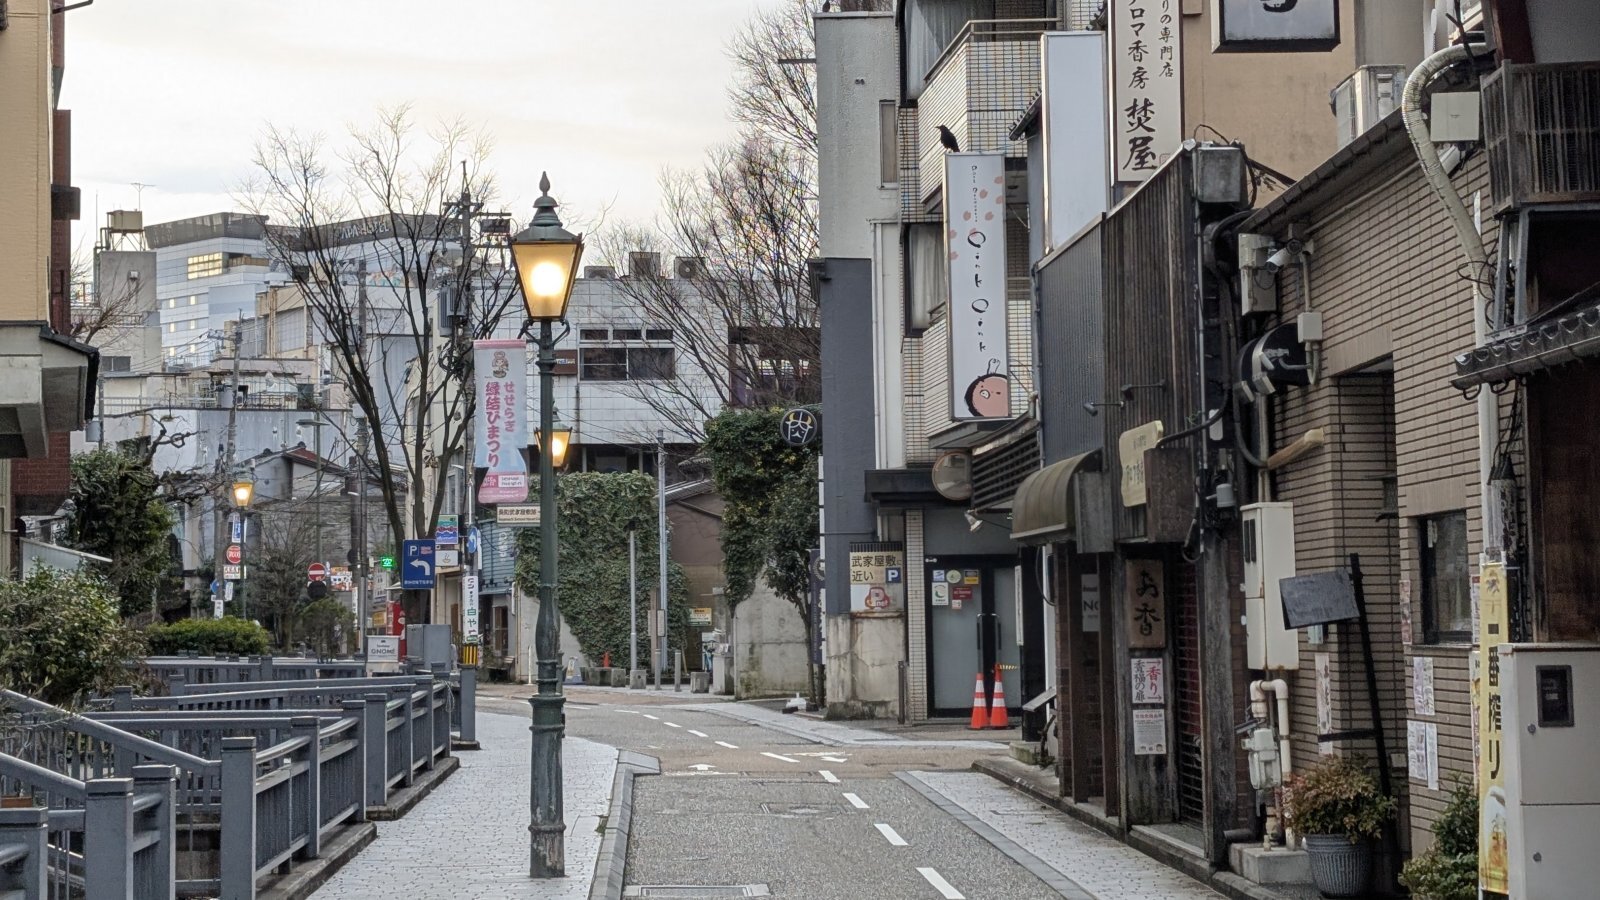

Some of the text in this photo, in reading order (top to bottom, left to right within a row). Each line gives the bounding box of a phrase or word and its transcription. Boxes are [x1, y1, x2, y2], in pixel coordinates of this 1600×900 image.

[1122, 97, 1159, 172] 焚屋
[967, 230, 990, 352] Oink Oink
[485, 381, 500, 468] 縁結びまつり
[503, 381, 516, 433] せせらぎ
[409, 545, 418, 556] P
[852, 569, 899, 582] 近い P
[1146, 666, 1162, 695] 香り
